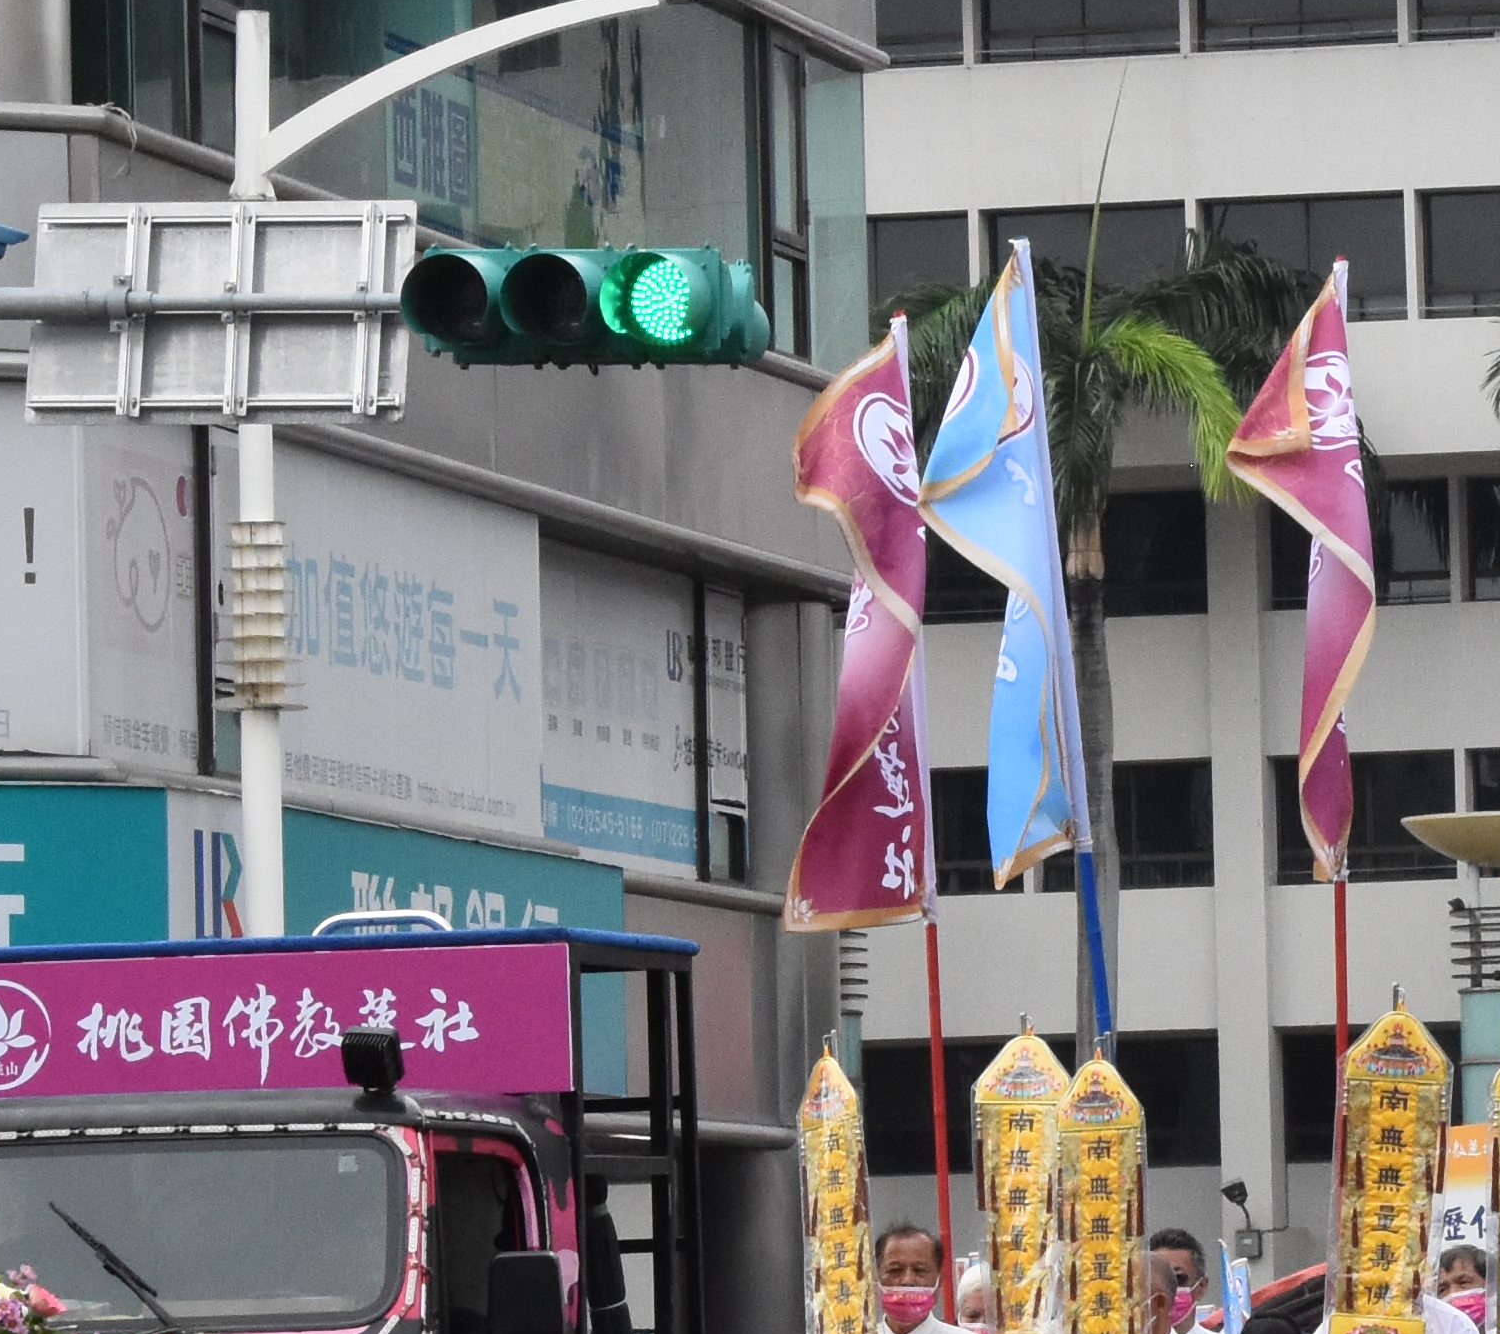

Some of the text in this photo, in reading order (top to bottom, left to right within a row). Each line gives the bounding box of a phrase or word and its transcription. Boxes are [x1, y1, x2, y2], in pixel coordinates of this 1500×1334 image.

[1364, 1084, 1410, 1311] 南無無量壽佛
